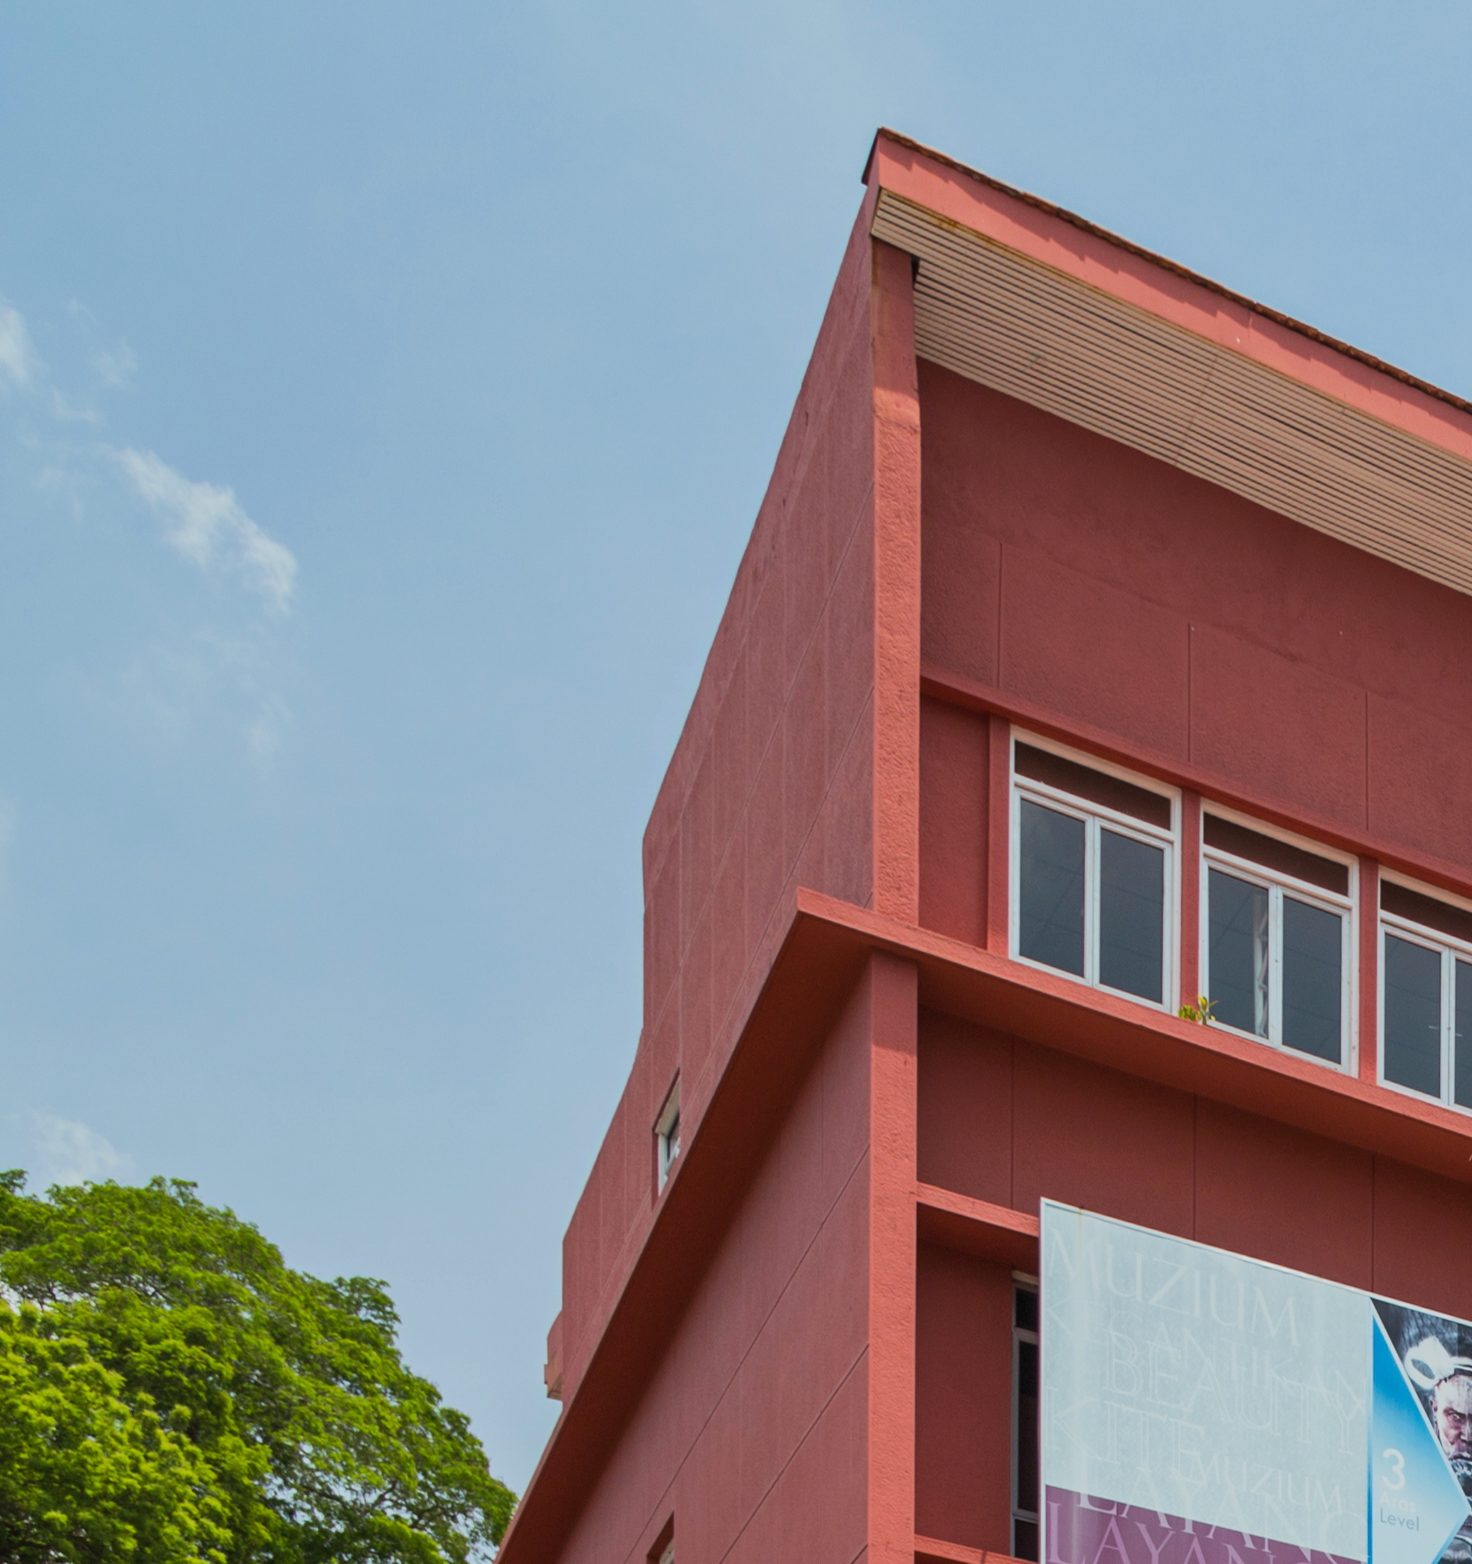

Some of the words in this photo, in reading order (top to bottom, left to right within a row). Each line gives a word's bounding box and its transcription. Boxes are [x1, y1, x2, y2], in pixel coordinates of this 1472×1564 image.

[1048, 1228, 1299, 1347] MUZIUM
[1382, 1448, 1405, 1490] 3
[1380, 1507, 1419, 1532] Level
